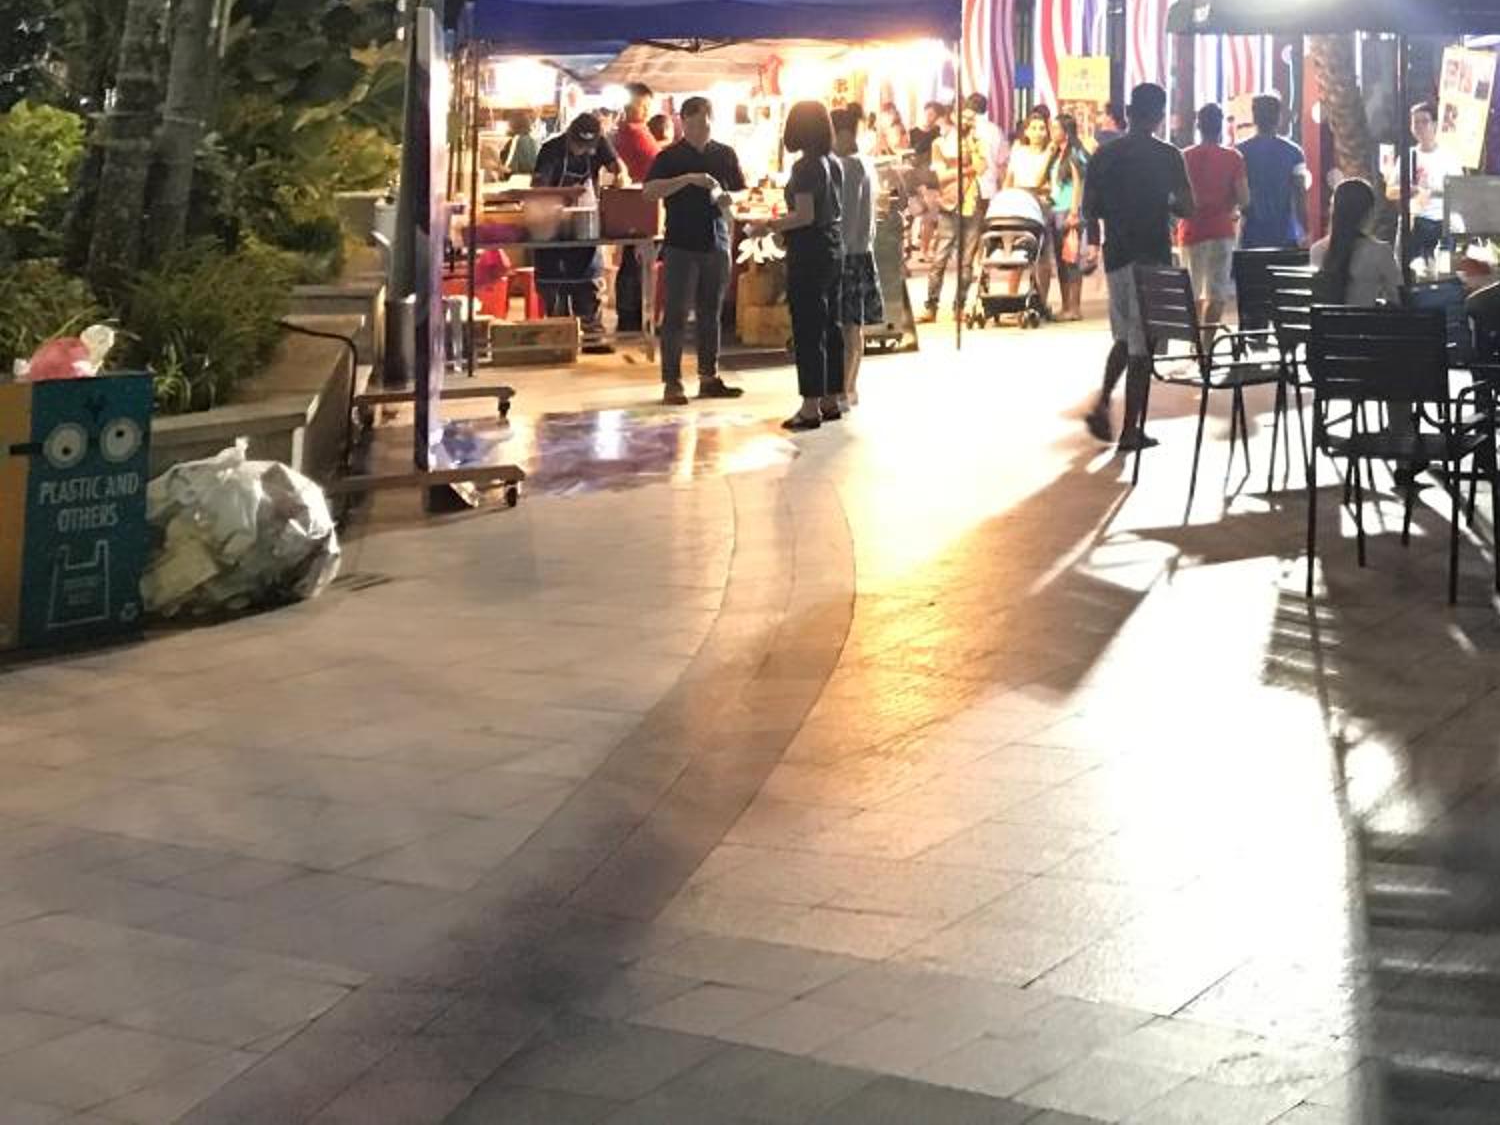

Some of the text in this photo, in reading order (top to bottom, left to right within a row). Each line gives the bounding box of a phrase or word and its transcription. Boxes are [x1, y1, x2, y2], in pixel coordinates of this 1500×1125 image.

[38, 472, 139, 505] PLASTIC AND
[56, 503, 120, 532] OTHERS
